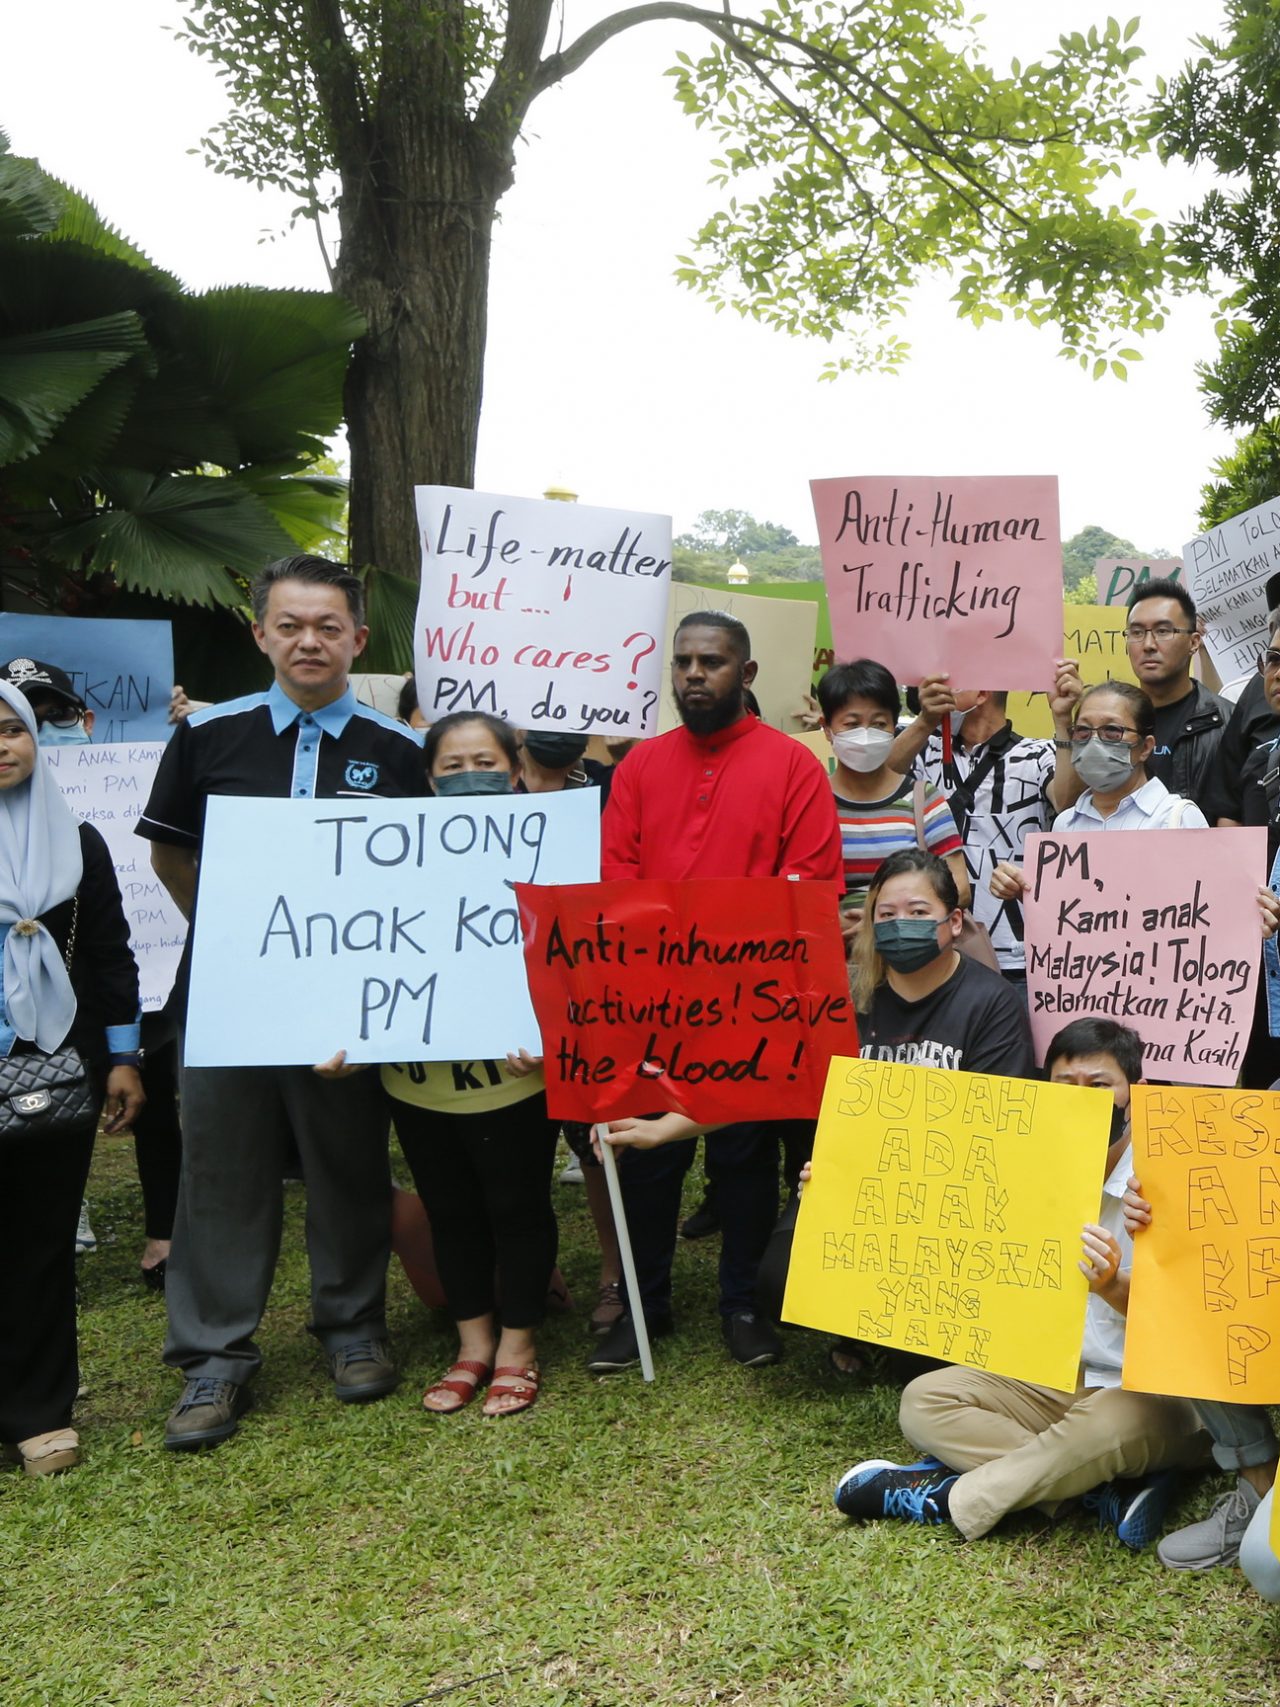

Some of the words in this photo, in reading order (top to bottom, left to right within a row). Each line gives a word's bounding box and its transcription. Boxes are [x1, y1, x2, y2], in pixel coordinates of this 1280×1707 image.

[835, 488, 1047, 548] Anti-Human
[1191, 529, 1229, 574] PM
[1192, 551, 1270, 602] SELAMATKAN
[447, 573, 513, 611] but
[843, 559, 1021, 640] Trafficking
[425, 621, 500, 666] Who
[531, 681, 567, 720] do
[572, 690, 658, 731] you?
[78, 749, 120, 768] ANAK
[60, 779, 87, 795] ami
[104, 775, 138, 793] PM
[123, 804, 143, 818] dik
[125, 881, 163, 900] PM
[1034, 839, 1104, 903] PM,
[131, 909, 167, 925] PM
[259, 895, 426, 959] Anak
[455, 896, 522, 953] Ka
[1057, 893, 1130, 935] Kami
[1142, 880, 1211, 932] anak
[1168, 935, 1251, 996] Tolong
[359, 973, 438, 1045] PM
[751, 979, 849, 1026] Save
[1034, 980, 1168, 1019] selamatkan
[556, 1036, 616, 1085] the
[1183, 1029, 1240, 1071] Kasih
[838, 1062, 1037, 1135] SUDAH
[878, 1128, 998, 1184] ADA
[853, 1177, 1009, 1233] ANAK
[823, 1232, 1062, 1290] MALAYSIA
[877, 1274, 980, 1319] YANG
[857, 1310, 991, 1369] MATI
[1227, 1324, 1271, 1386] P
